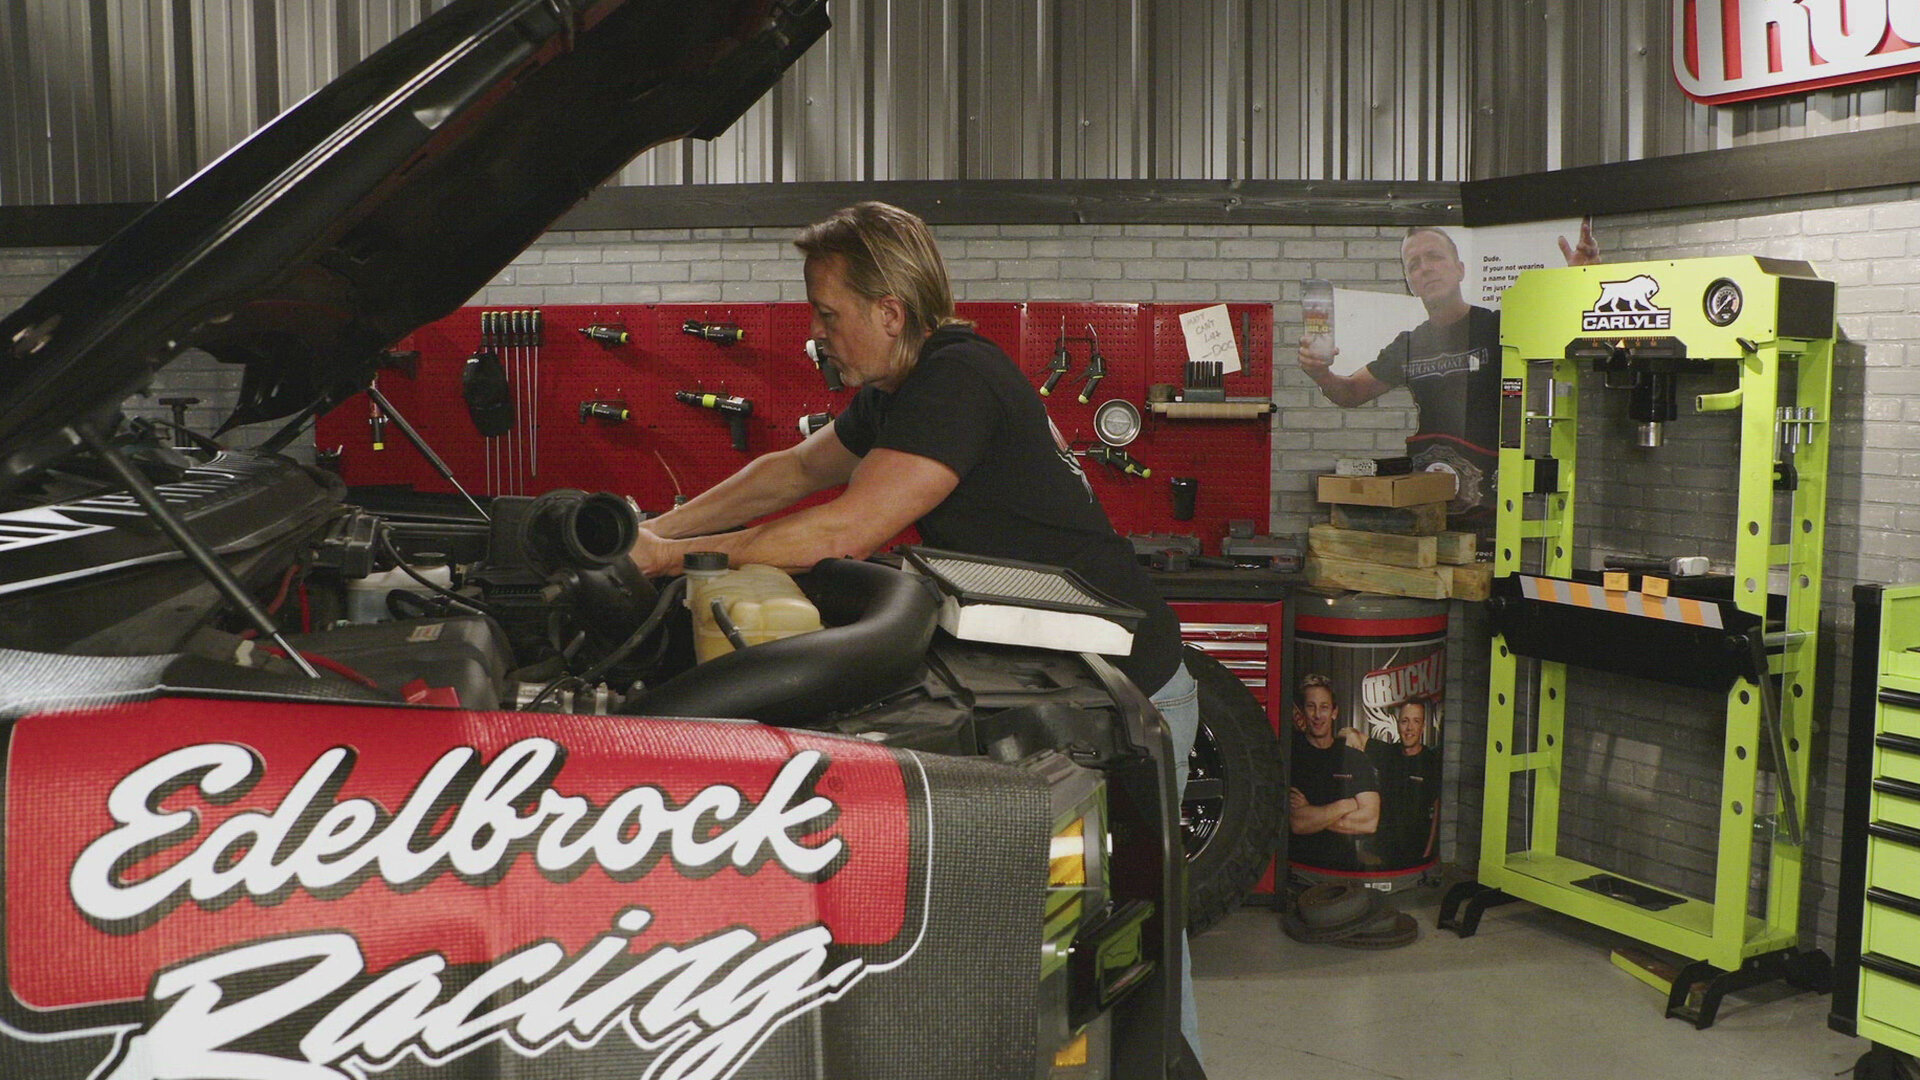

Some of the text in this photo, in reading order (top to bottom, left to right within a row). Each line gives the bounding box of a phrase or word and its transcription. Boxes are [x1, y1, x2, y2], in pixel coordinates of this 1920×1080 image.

[1583, 315, 1669, 330] CARLYLE
[69, 737, 845, 924] Edelbrock
[104, 909, 863, 1080] Racing
